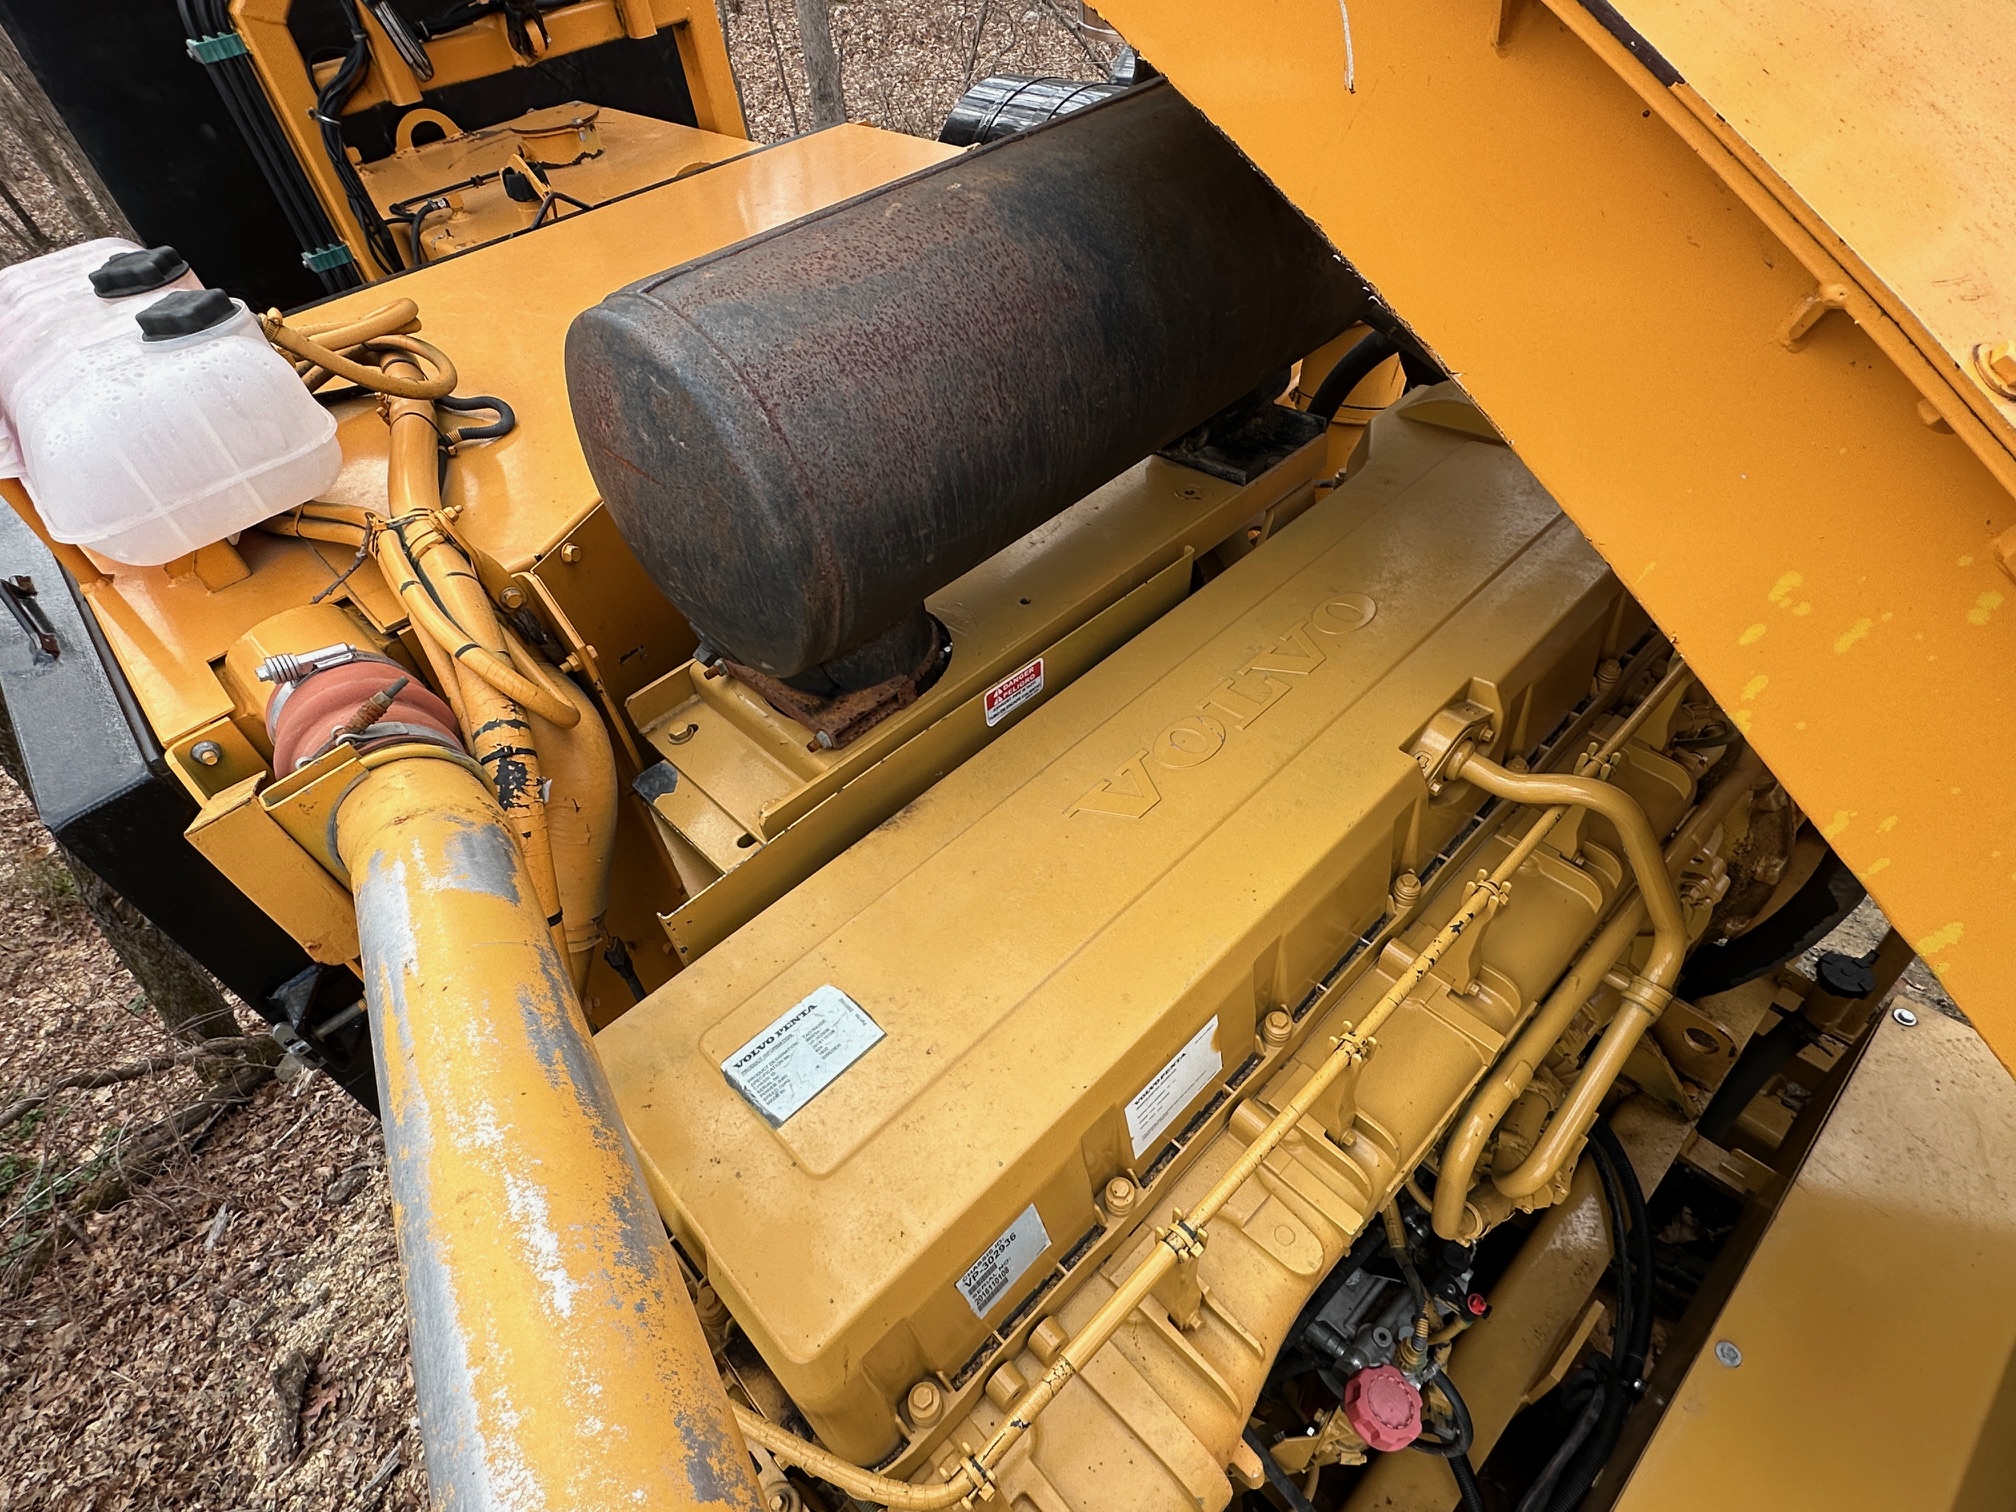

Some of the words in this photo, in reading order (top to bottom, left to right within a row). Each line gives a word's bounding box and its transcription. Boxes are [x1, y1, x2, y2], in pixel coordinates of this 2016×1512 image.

[1002, 666, 1035, 691] DANGER
[1002, 673, 1036, 699] PELIGRO
[1061, 592, 1378, 820] VOLVO
[733, 1036, 775, 1069] VOLVO
[774, 1004, 818, 1037] PENTA
[821, 1043, 842, 1060] SWEDEN
[741, 1057, 763, 1076] PRODUCT
[1134, 1078, 1161, 1106] VOLVO
[1160, 1053, 1186, 1080] PENTA
[962, 1248, 993, 1282] CHASSIS
[964, 1231, 1017, 1288] VP-302936
[972, 1272, 998, 1299] SERIAL
